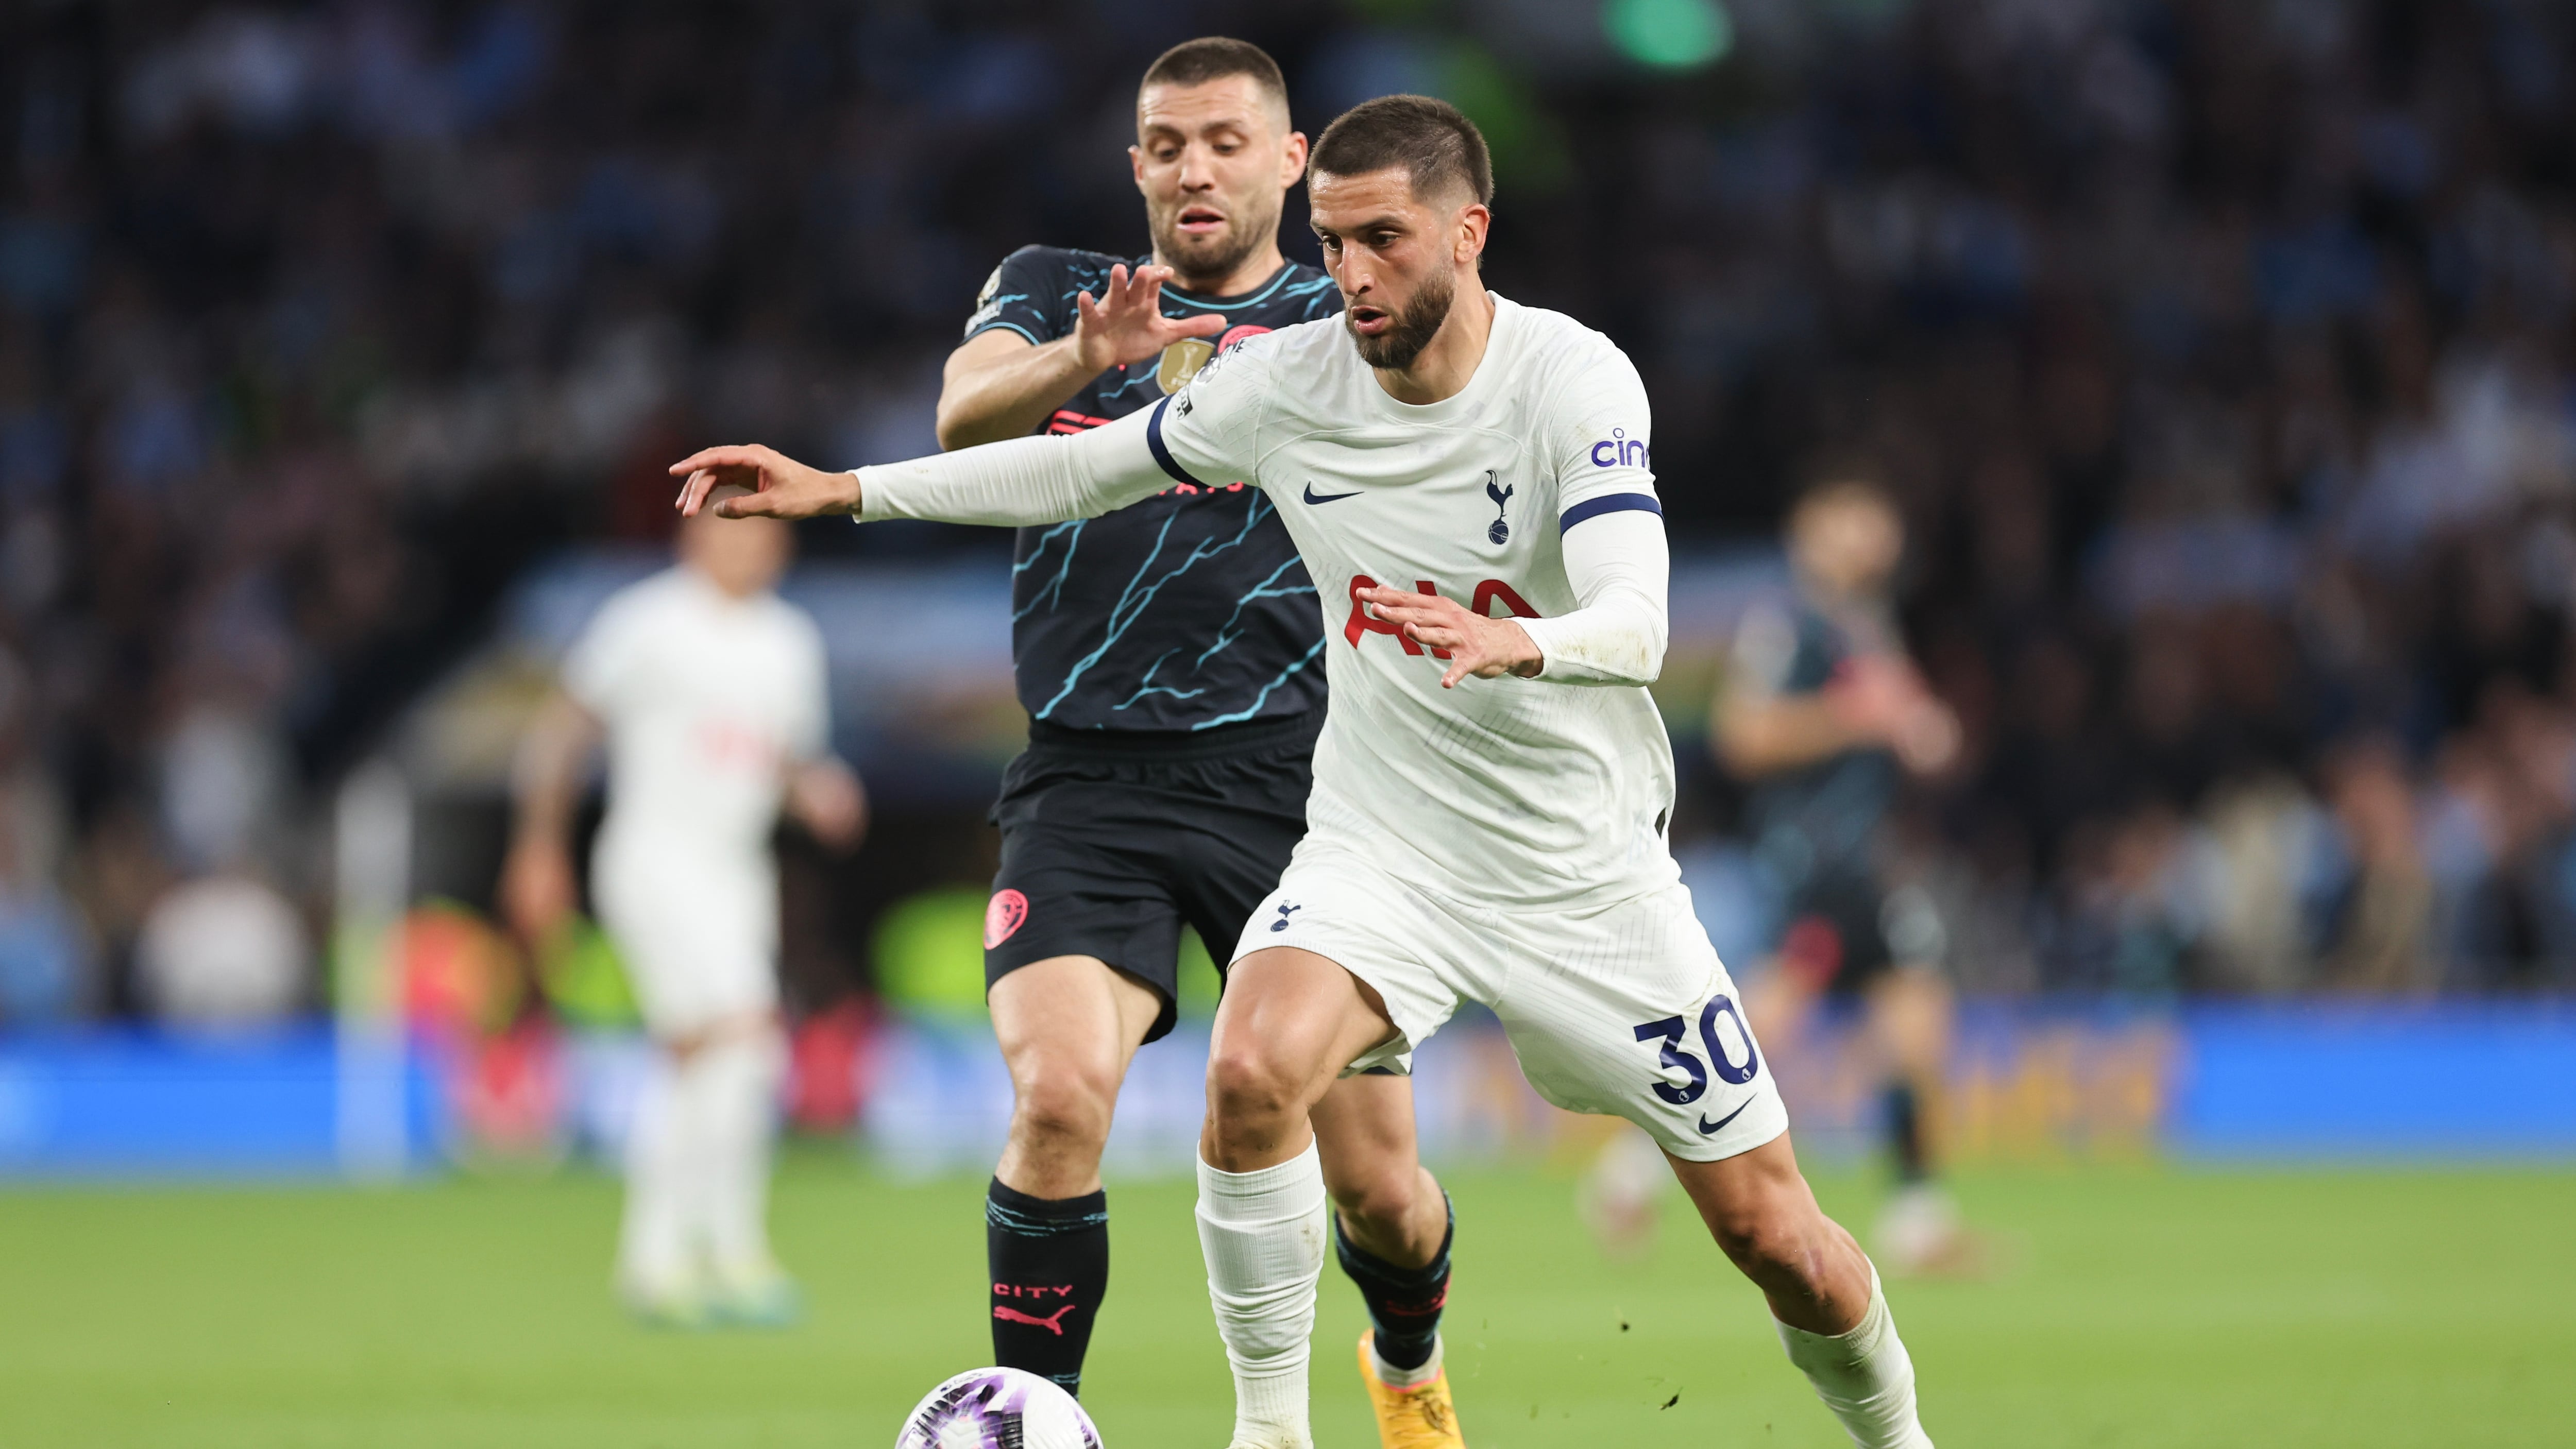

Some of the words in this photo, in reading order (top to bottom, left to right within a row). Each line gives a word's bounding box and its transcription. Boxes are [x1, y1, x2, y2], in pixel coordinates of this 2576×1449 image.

[1591, 428, 1649, 468] cin
[1633, 994, 1758, 1105] 30
[993, 1283, 1073, 1299] CITY
